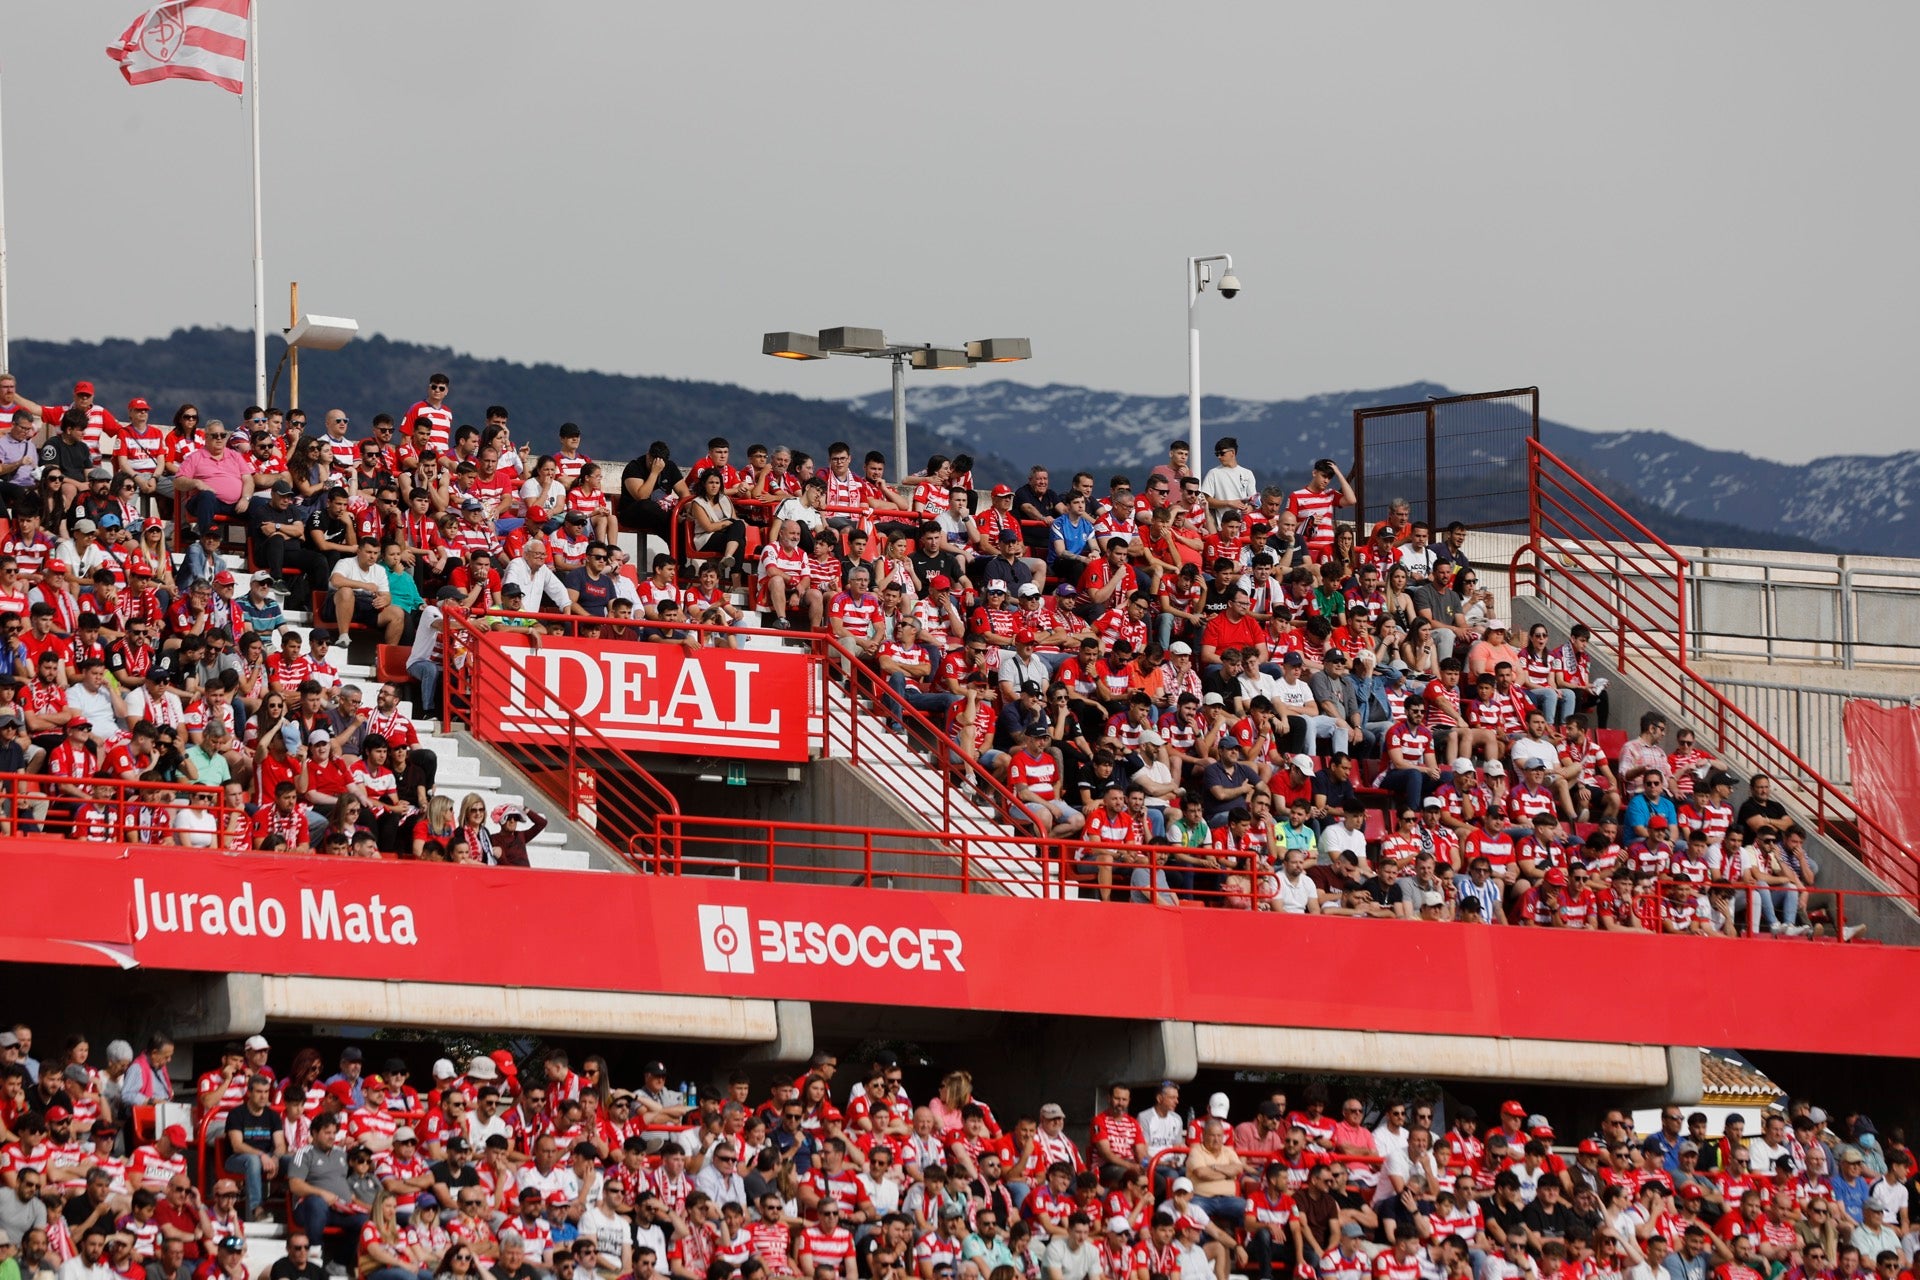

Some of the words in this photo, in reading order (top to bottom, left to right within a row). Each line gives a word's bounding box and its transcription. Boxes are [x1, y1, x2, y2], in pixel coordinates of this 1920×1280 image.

[500, 645, 780, 734] IDEAL
[133, 878, 286, 940] Jurado
[300, 888, 418, 946] Mata
[758, 919, 966, 972] BESOCCER
